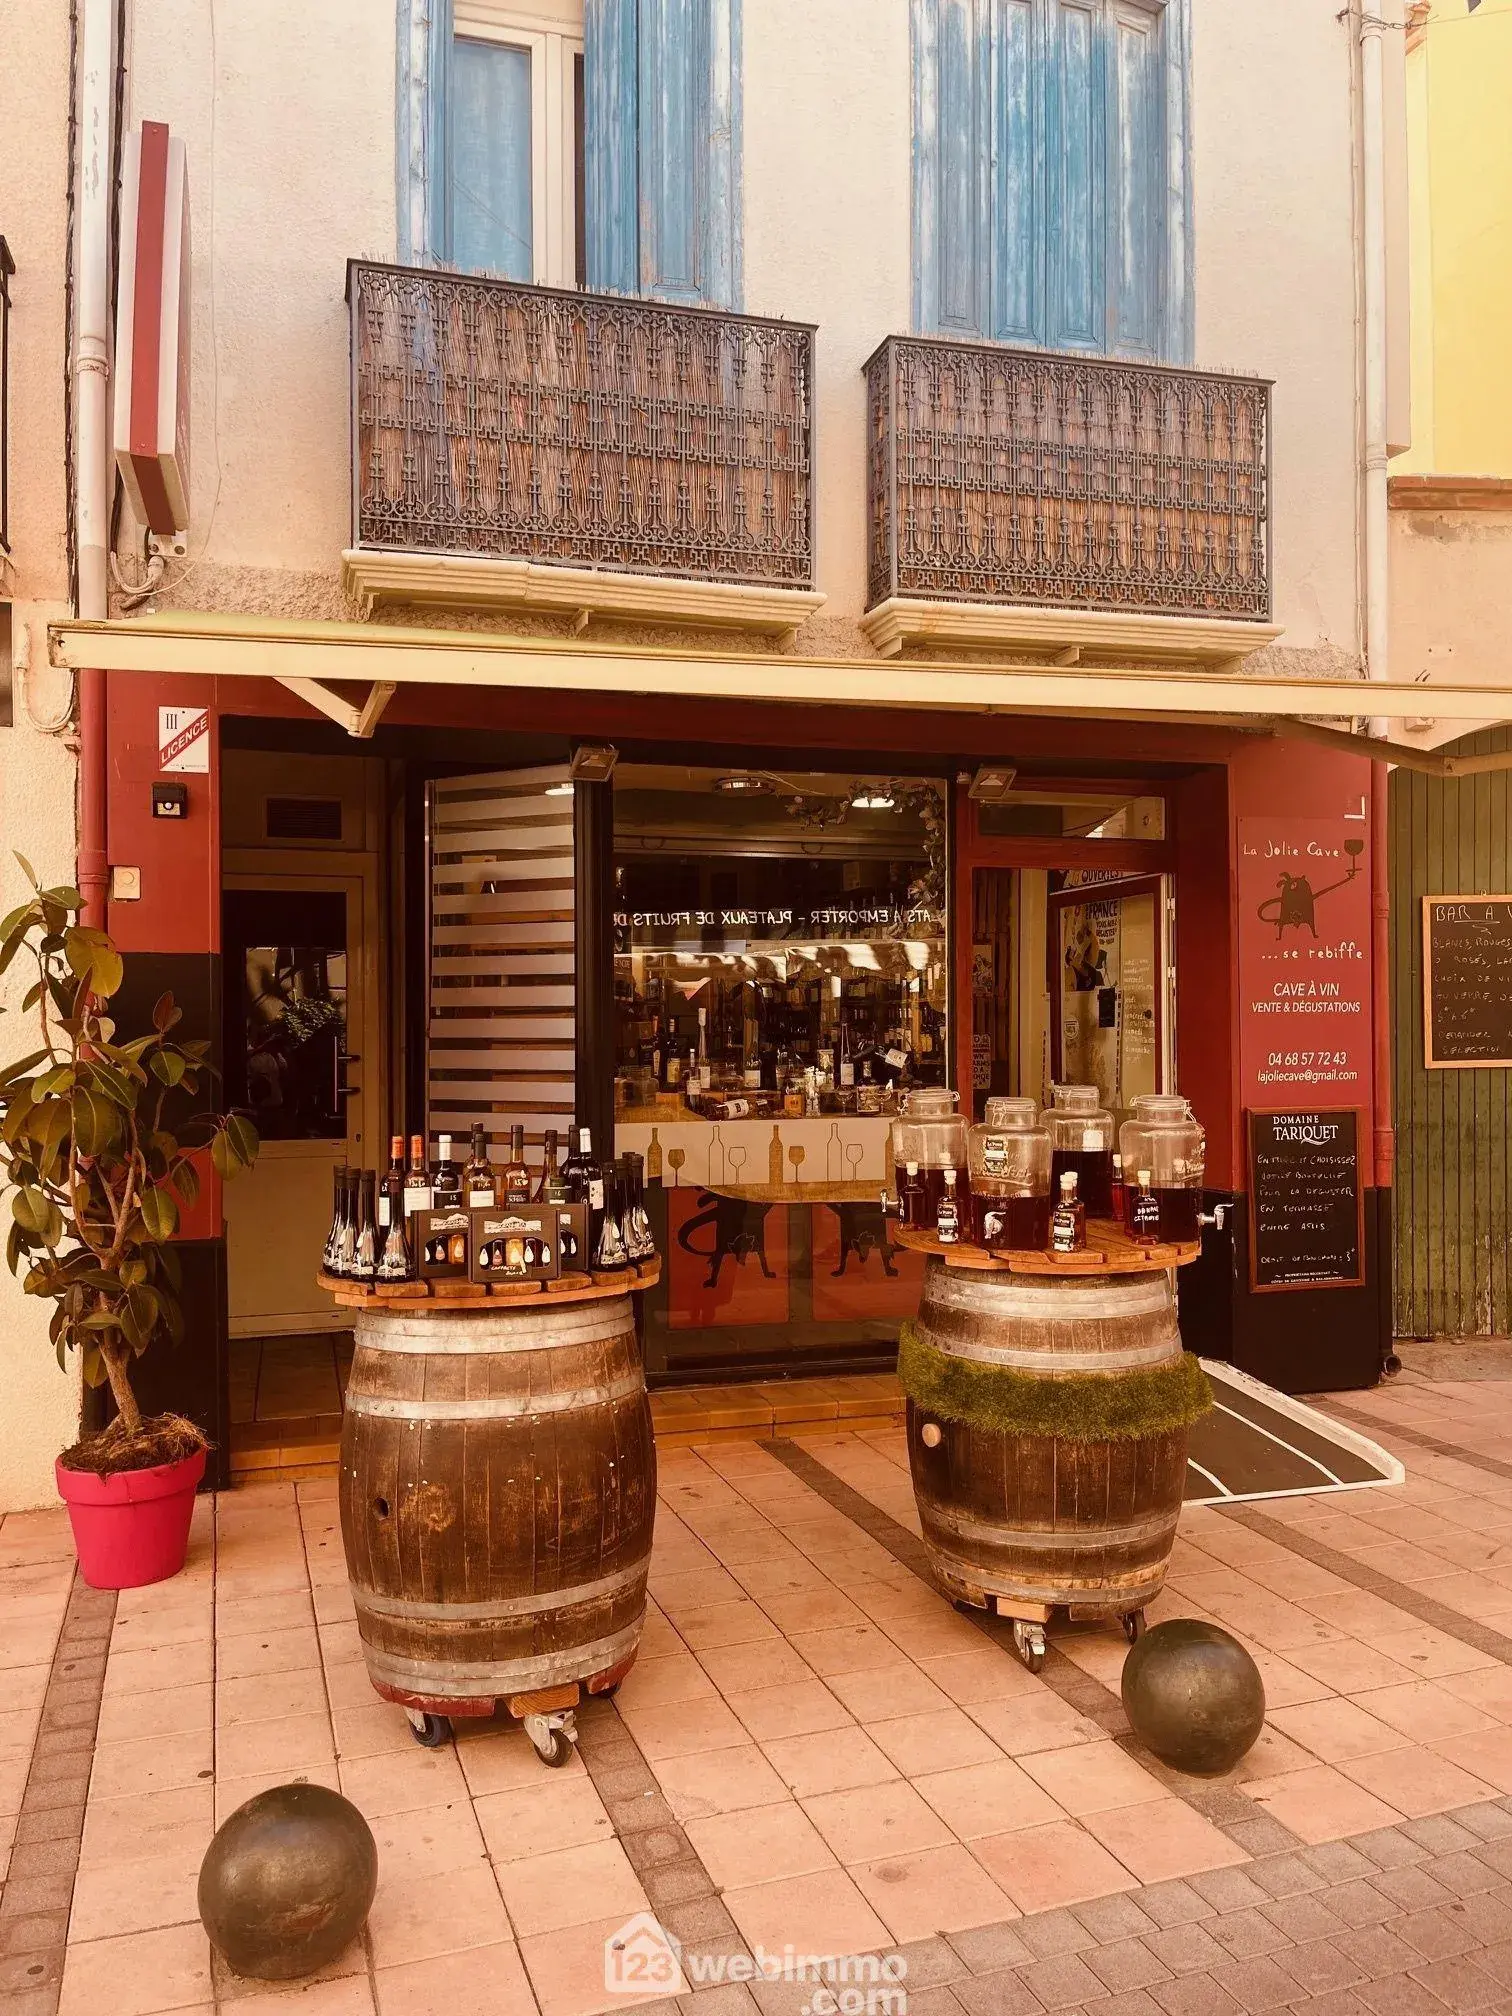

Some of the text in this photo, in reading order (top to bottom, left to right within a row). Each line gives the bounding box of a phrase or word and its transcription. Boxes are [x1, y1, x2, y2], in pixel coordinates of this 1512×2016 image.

[166, 714, 178, 729] III
[161, 716, 208, 764] LICENCE
[1243, 840, 1340, 858] La Jolie Cave
[1436, 905, 1471, 922] BAR
[1485, 905, 1494, 920] A
[1308, 941, 1363, 959] rebiffe
[1273, 980, 1340, 997] CAVE À VIN
[1252, 1000, 1361, 1013] VENTE & DÉGUSTATIONS
[1268, 1051, 1347, 1066] 04 68 57 72 43
[1257, 1069, 1358, 1084] lajoliecave@gmail.com
[1272, 1115, 1320, 1125] DOMAINE
[1272, 1125, 1339, 1146] TARIQUET
